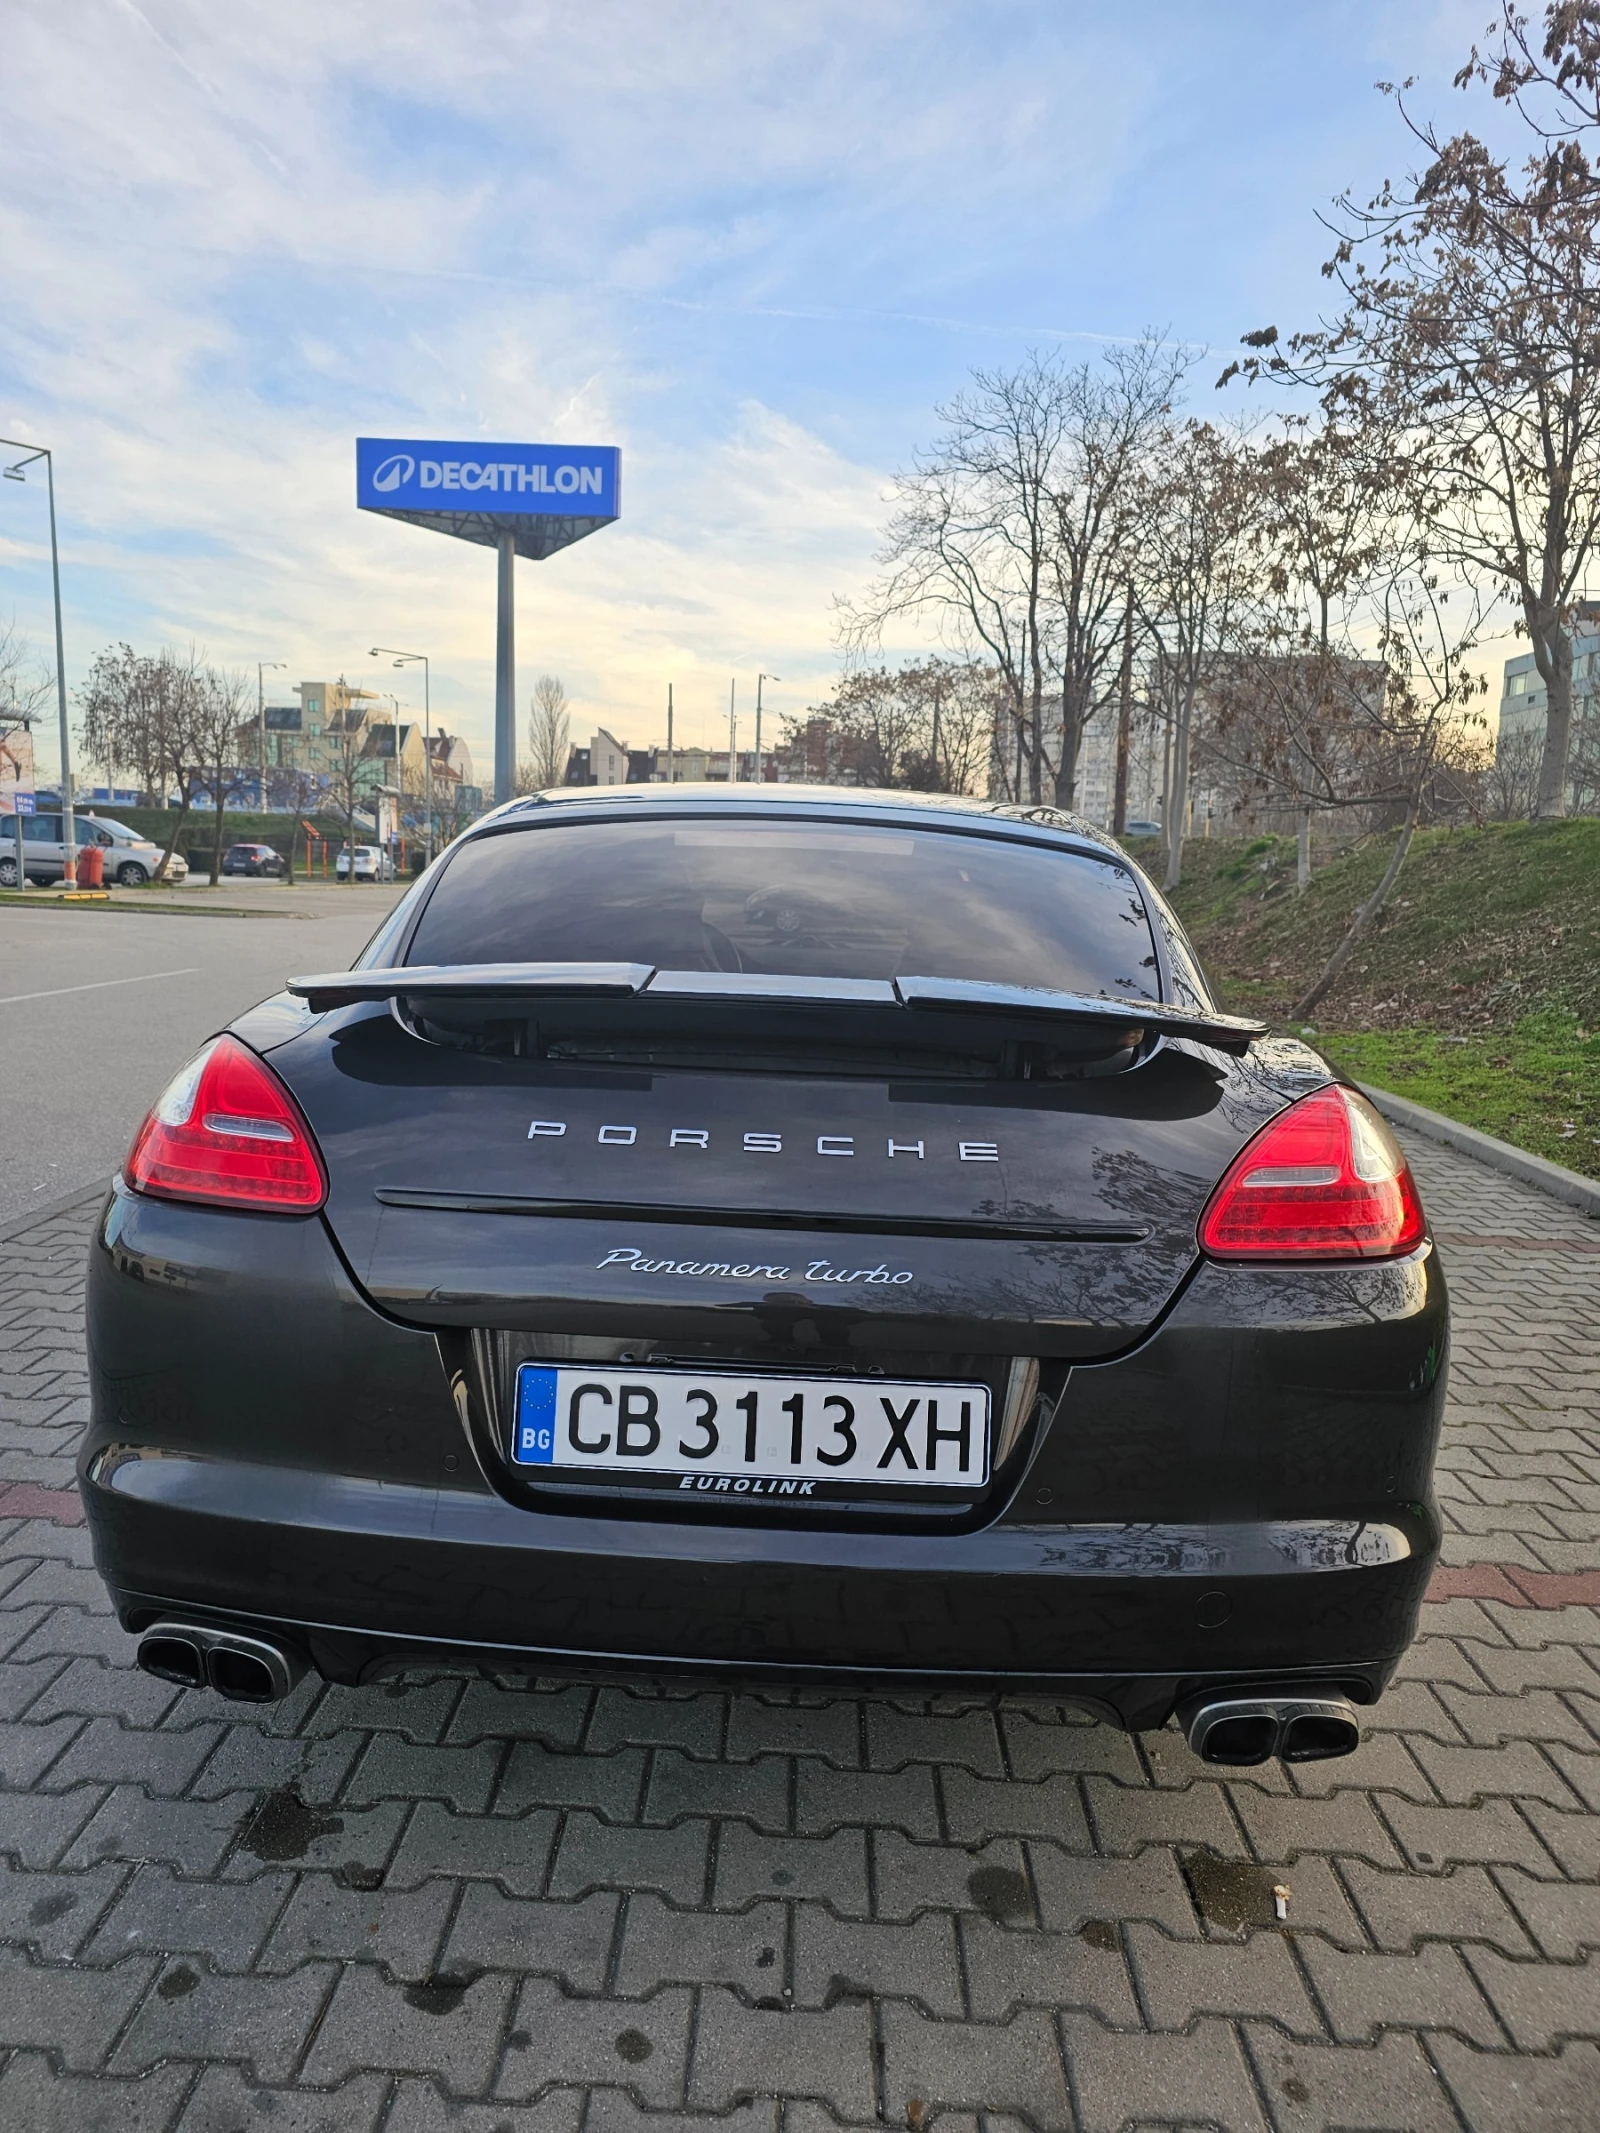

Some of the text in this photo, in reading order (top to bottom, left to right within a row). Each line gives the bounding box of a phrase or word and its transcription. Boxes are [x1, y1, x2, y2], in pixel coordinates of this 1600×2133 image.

[419, 460, 602, 495] DECATHLON
[527, 1120, 999, 1162] PORSCHE
[596, 1247, 913, 1285] Panamera turbo
[522, 1427, 551, 1450] BG
[568, 1383, 972, 1473] CB 3113 XH
[678, 1476, 817, 1496] EUROLINK
